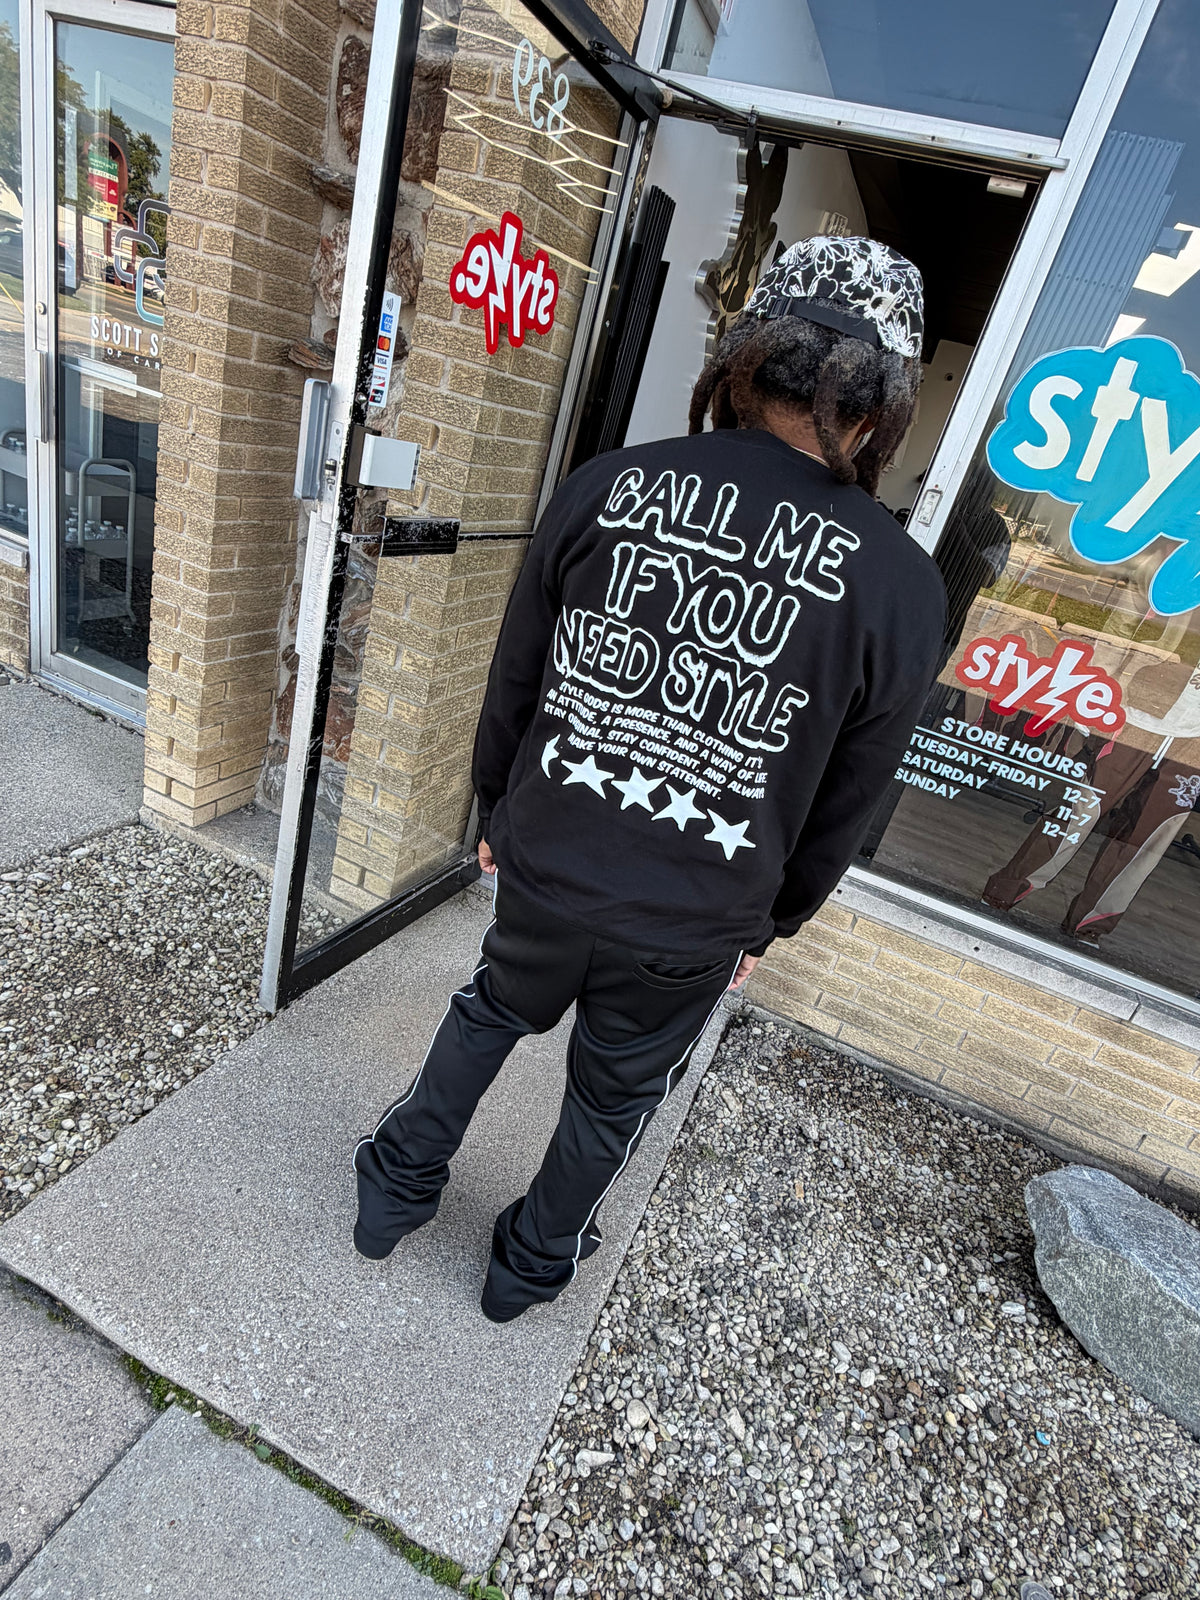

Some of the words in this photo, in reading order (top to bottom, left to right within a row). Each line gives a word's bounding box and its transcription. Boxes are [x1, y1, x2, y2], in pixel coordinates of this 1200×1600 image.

[91, 315, 142, 351] SCOTT
[149, 333, 166, 356] S
[107, 347, 122, 358] OF
[1013, 357, 1200, 533] sty
[596, 467, 746, 562] CALL
[754, 502, 861, 602] ME
[604, 542, 672, 619] IF
[666, 553, 801, 668] YOU
[553, 604, 660, 699] NEED
[660, 641, 810, 753] STYLE
[544, 702, 567, 719] STAY
[568, 712, 603, 740] ORGINAL,
[607, 730, 639, 744] STAY
[639, 739, 700, 772] CONFIDENT,
[702, 766, 726, 784] AND
[546, 688, 558, 701] AN
[600, 716, 612, 726] A
[612, 718, 671, 744] PRESENCE,
[674, 736, 698, 753] AND
[699, 749, 710, 760] A
[710, 754, 737, 773] WAY
[737, 768, 754, 781] OF
[559, 681, 584, 699] STYLE
[584, 692, 610, 712] GODS
[611, 703, 624, 714] IS
[624, 706, 660, 722] MORE
[662, 715, 692, 736] THAN
[692, 730, 744, 762] CLOTHING
[941, 717, 1010, 752] STORE
[1009, 740, 1088, 778] HOURS
[568, 732, 596, 751] MAKE
[597, 742, 628, 757] YOUR
[630, 750, 658, 768] OWN
[656, 760, 722, 800] STATEMENT.
[902, 750, 988, 790] SATURDAY
[1056, 806, 1092, 827] 11-7
[910, 733, 1051, 792] TUESDAY-FRIDAY
[1062, 786, 1102, 809] 12-7
[894, 768, 961, 800] SUNDAY
[1042, 821, 1081, 844] 12-4
